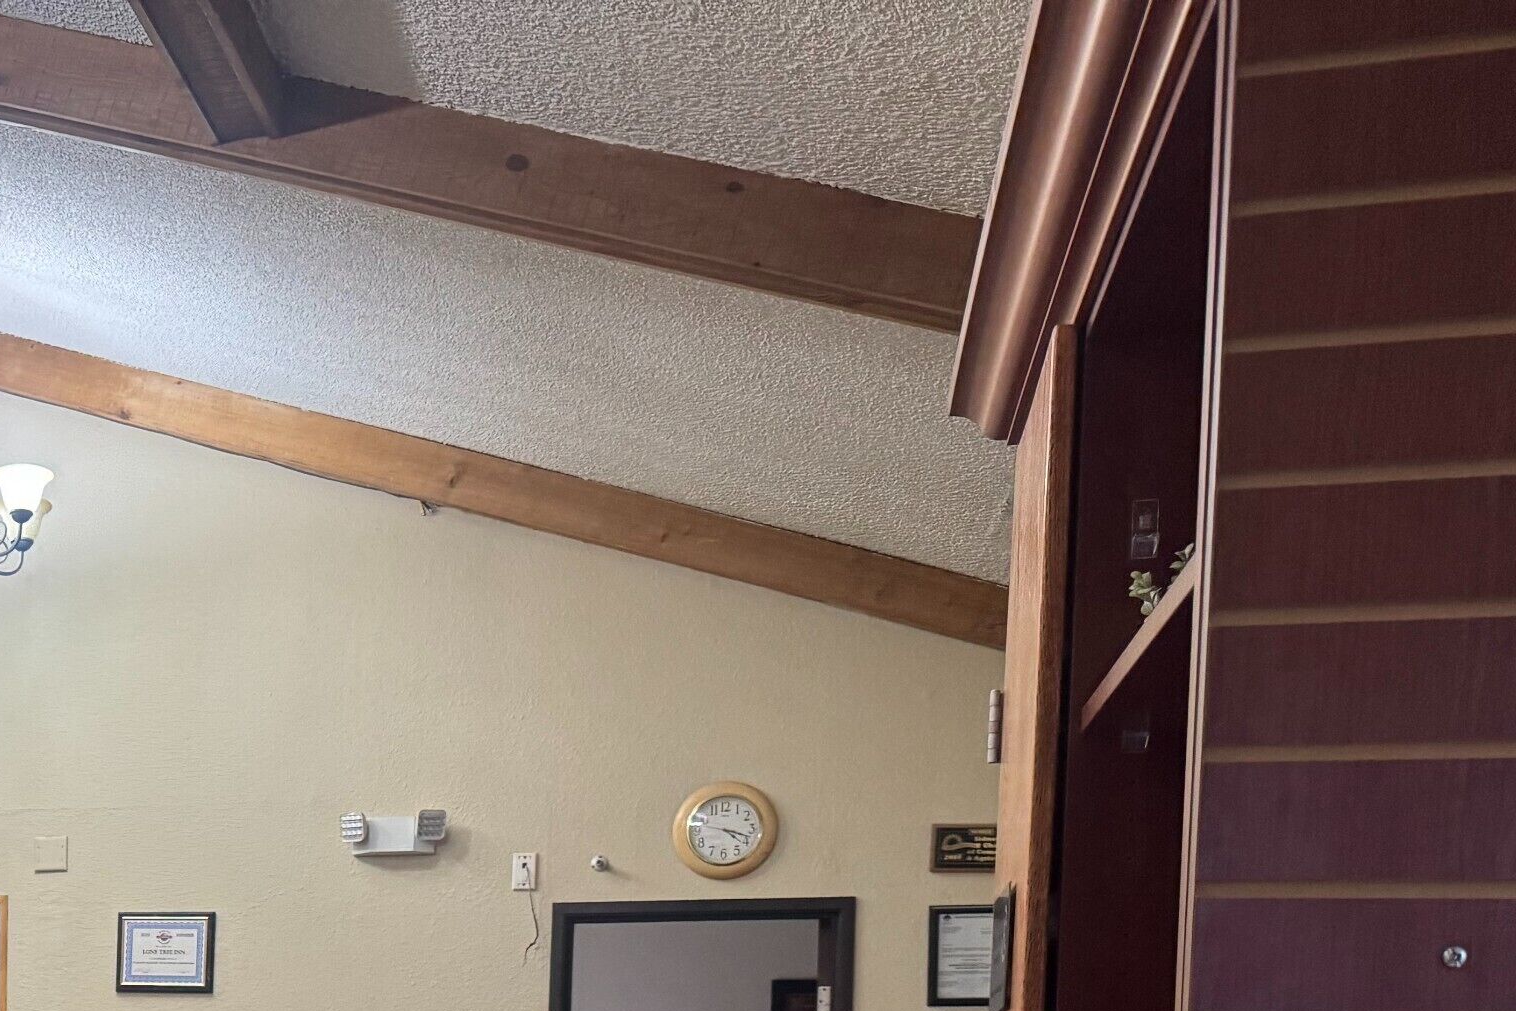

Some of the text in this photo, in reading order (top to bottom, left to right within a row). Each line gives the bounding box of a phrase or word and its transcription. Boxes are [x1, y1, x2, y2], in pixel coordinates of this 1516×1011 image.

[710, 804, 718, 816] 11
[721, 801, 731, 812] 12
[744, 810, 750, 821] 2
[694, 825, 701, 836] 9
[748, 823, 755, 834] 3
[698, 837, 705, 848] 8
[742, 835, 750, 846] 4
[708, 846, 715, 856] 7
[720, 848, 727, 860] 6
[733, 845, 740, 856] 5
